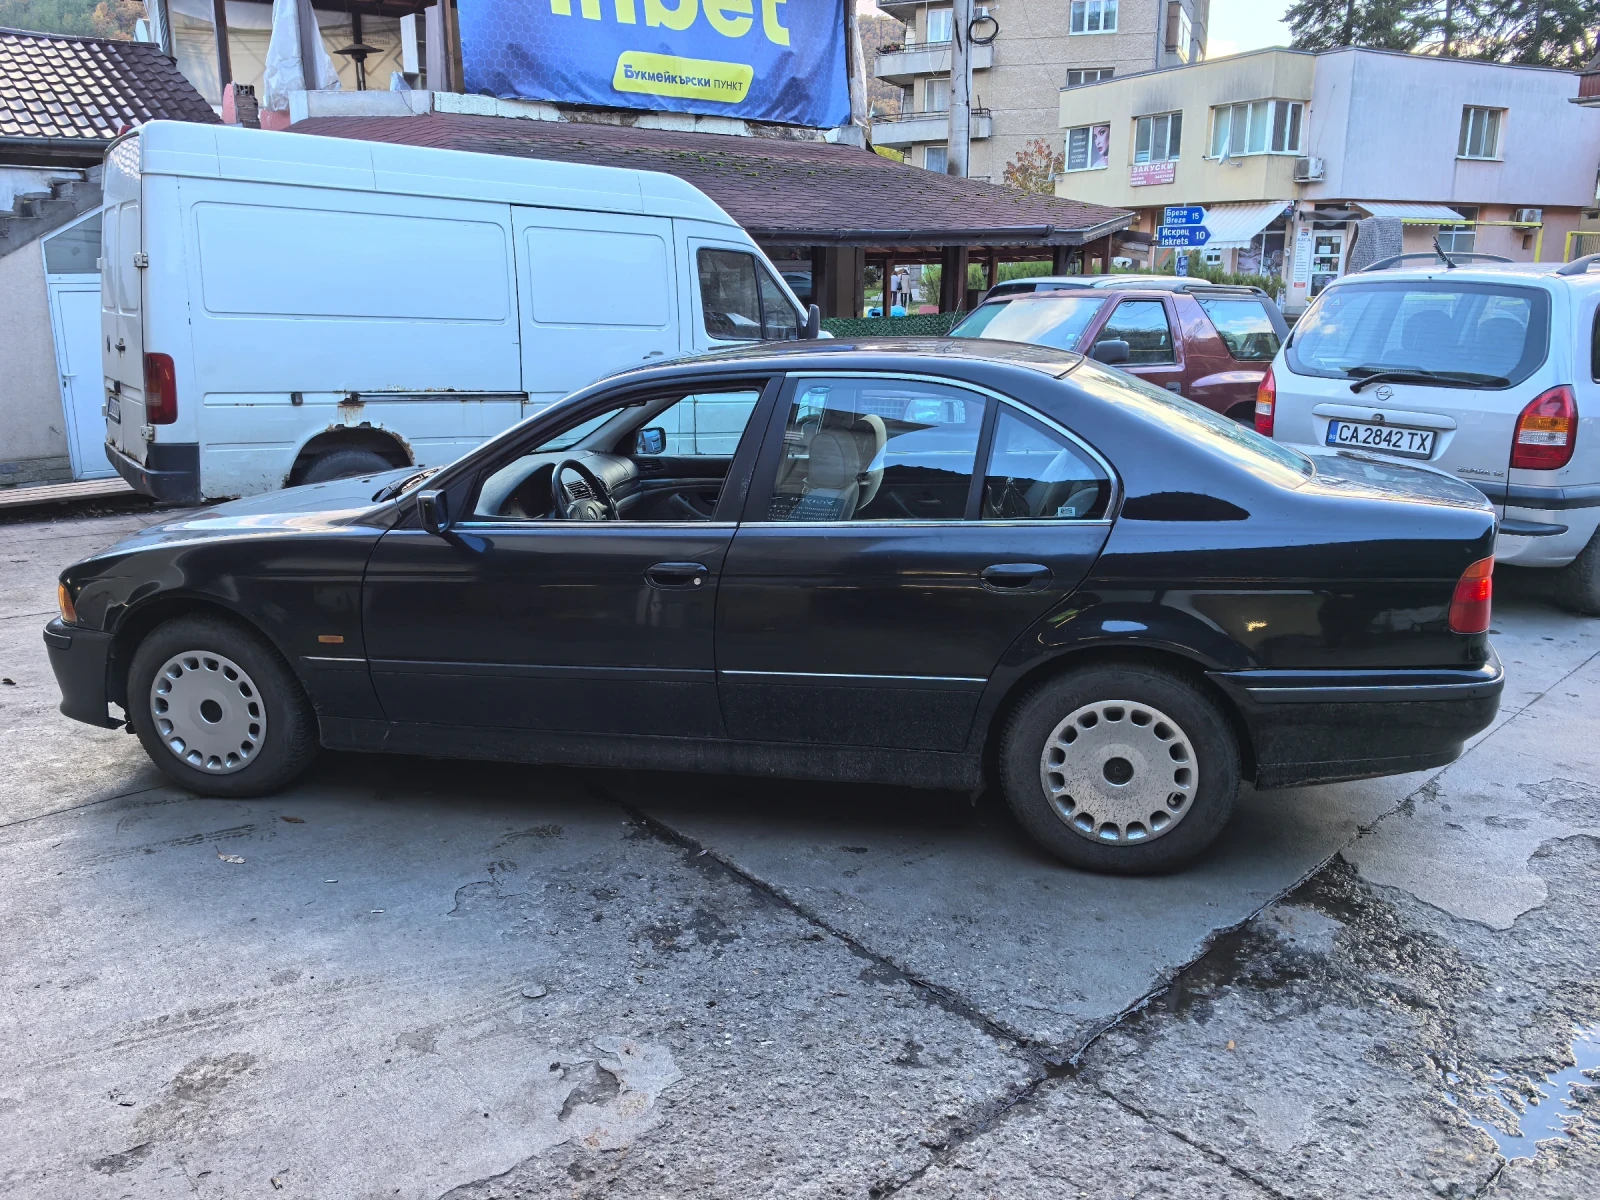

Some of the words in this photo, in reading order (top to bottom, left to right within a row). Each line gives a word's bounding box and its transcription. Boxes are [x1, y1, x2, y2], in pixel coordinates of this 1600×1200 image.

[1133, 163, 1174, 173] ЗАКУСКИ
[1166, 209, 1188, 217] Брезе
[1192, 212, 1200, 220] 15
[1162, 228, 1190, 237] Искрец
[1196, 231, 1206, 240] 10
[1162, 237, 1189, 245] Iskrets
[1339, 424, 1359, 444] CA
[1362, 427, 1404, 448] 2842
[1407, 431, 1430, 452] TX
